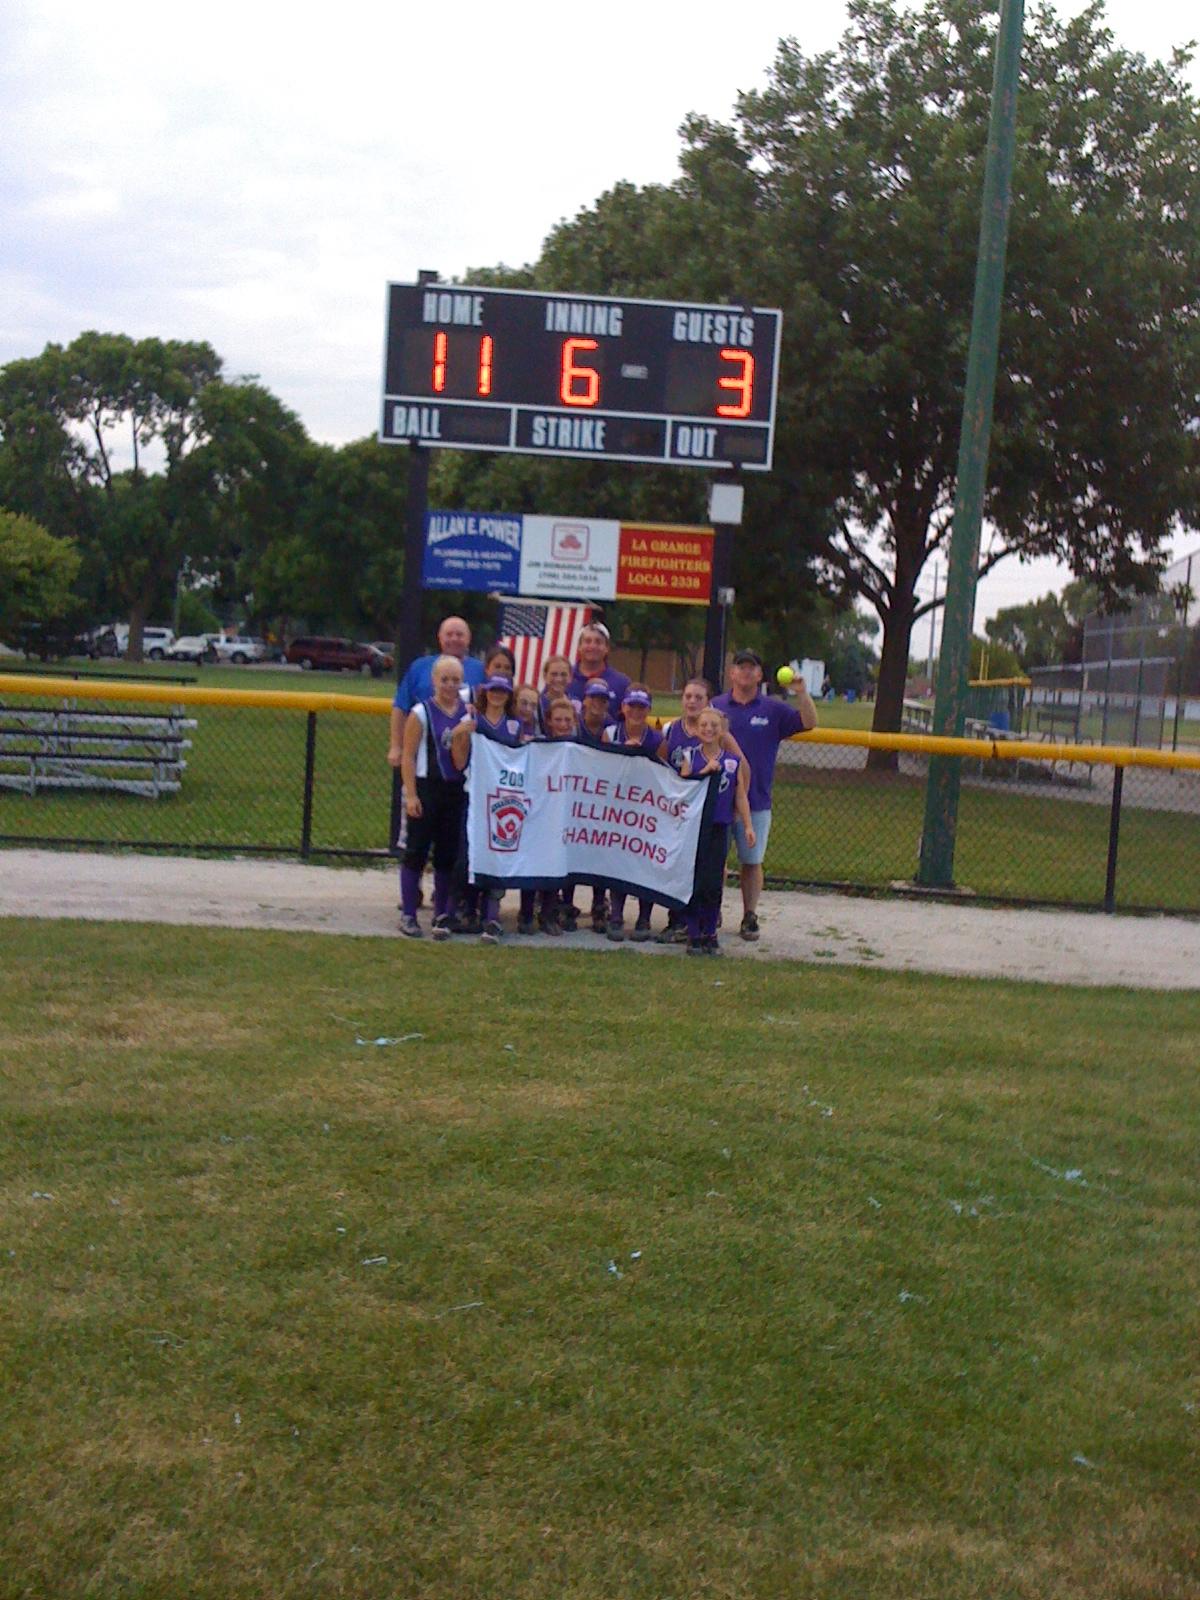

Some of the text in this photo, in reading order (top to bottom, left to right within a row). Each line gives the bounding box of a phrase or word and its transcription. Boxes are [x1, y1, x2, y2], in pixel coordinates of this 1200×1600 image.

[423, 292, 485, 326] HOME
[545, 301, 623, 337] INNING
[672, 311, 755, 347] GUESTS
[559, 337, 600, 407] 6
[716, 348, 755, 418] 3
[392, 405, 442, 438] BALL
[531, 415, 607, 450] STRIKE
[676, 425, 718, 459] OUT
[620, 555, 710, 572] FIREFIGHTERS
[632, 538, 701, 555] LA GRANGE
[628, 572, 667, 587] LOCAL
[547, 775, 690, 820] LITTLE LEAGUE
[572, 801, 657, 833] ILLINOIS
